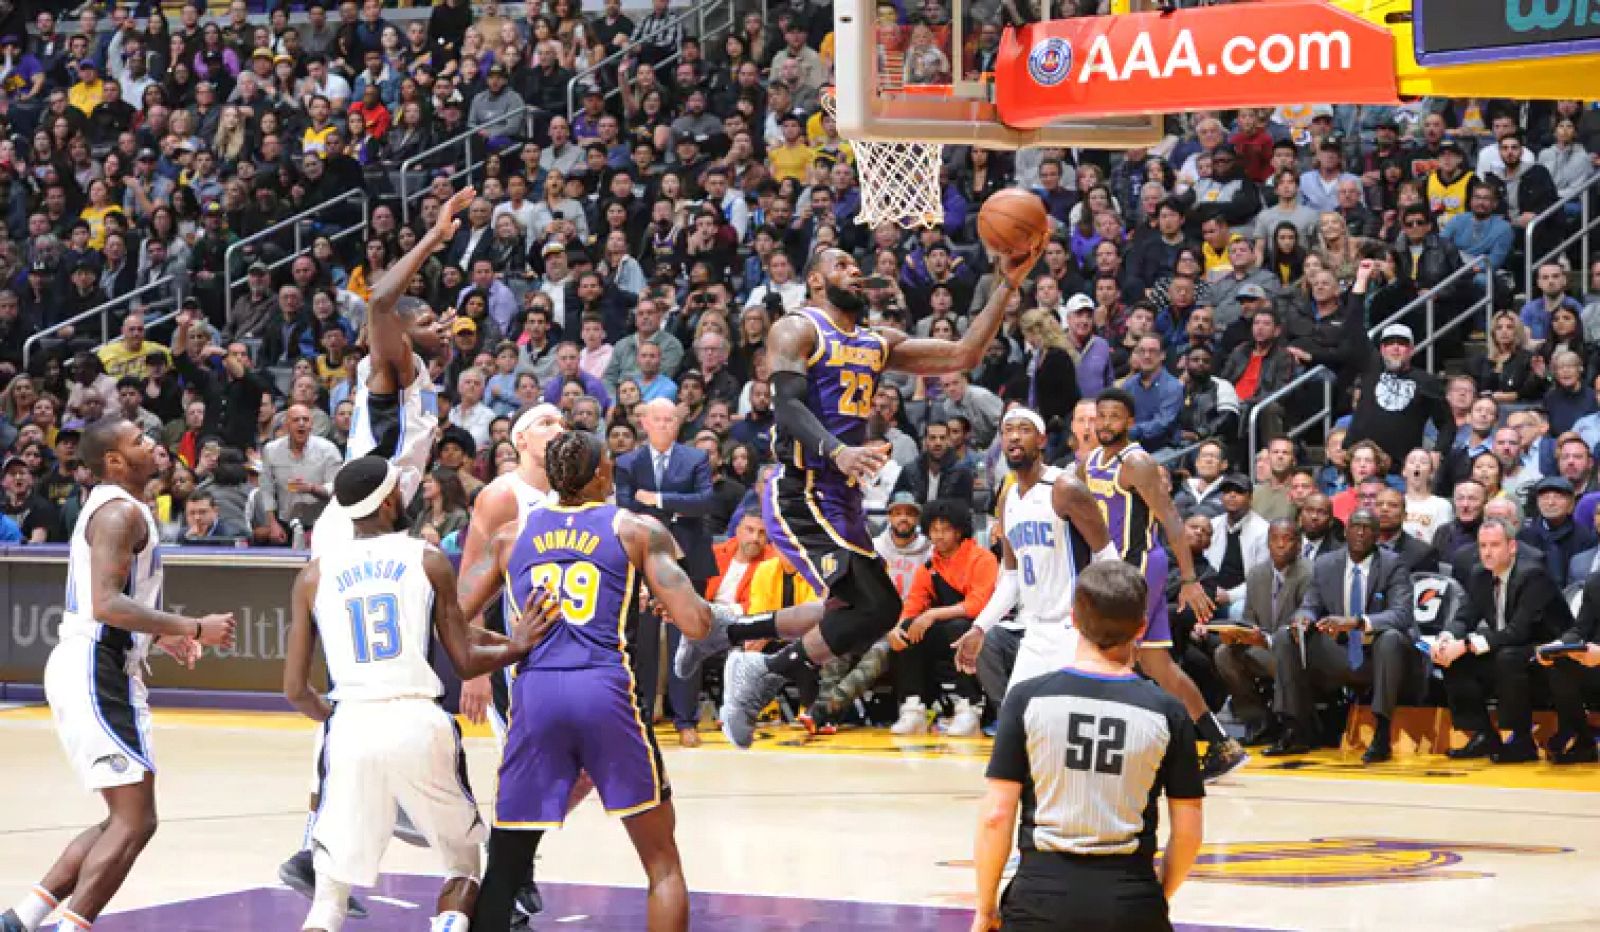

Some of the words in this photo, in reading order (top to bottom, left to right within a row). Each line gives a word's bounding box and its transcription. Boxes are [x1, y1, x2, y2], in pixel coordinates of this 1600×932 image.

[1077, 30, 1351, 83] AAA.com
[838, 370, 874, 417] 23
[533, 529, 600, 554] HOWARD
[336, 559, 407, 593] JOHNSON
[1023, 554, 1036, 586] 8
[345, 593, 403, 663] 13
[1066, 713, 1126, 775] 52
